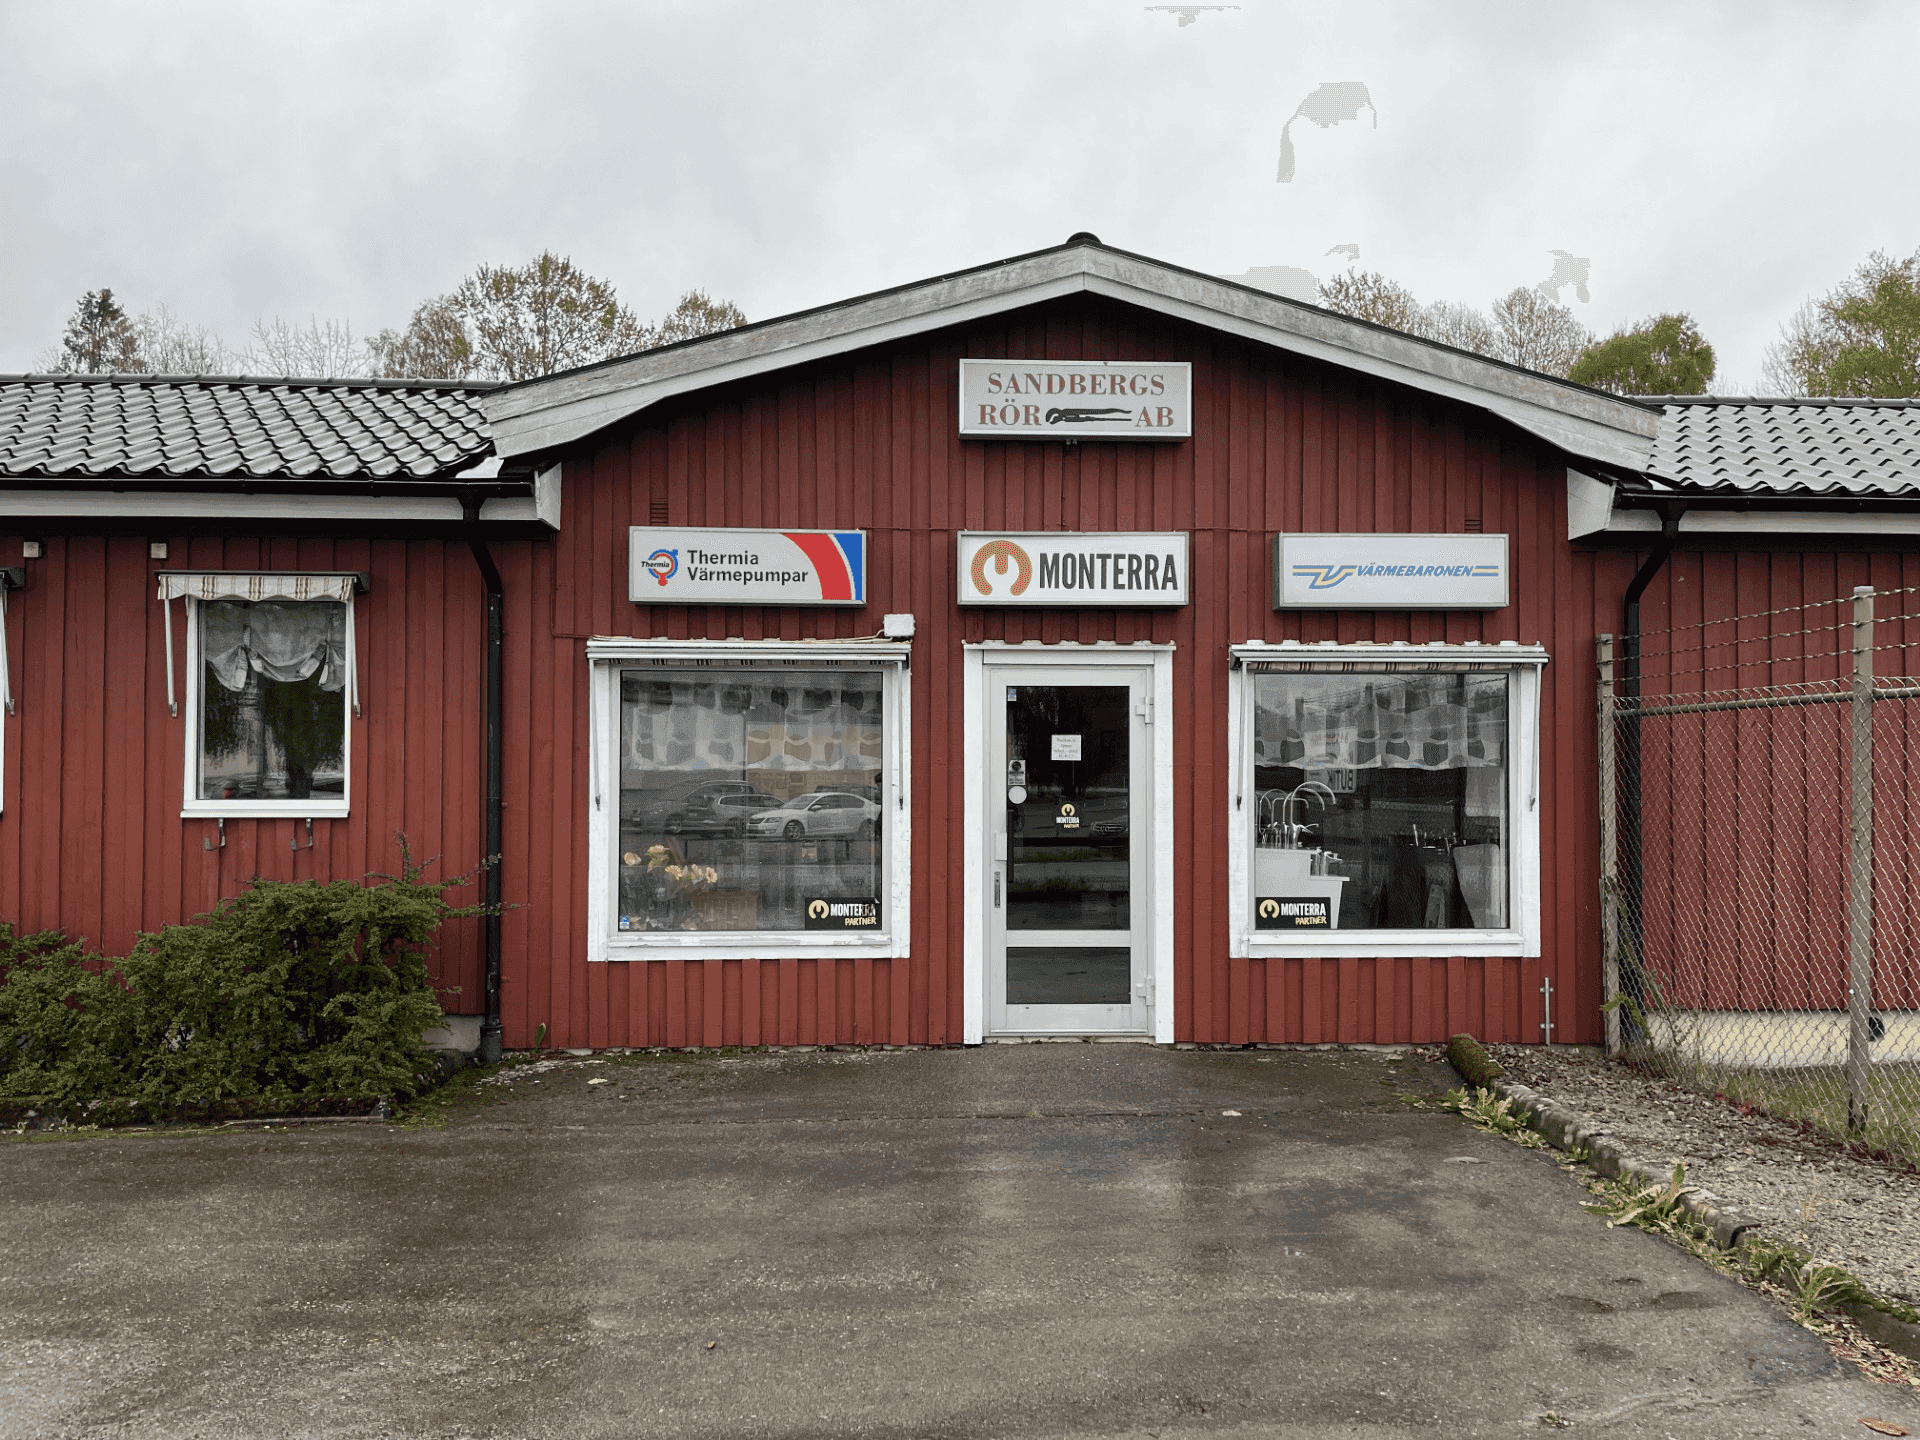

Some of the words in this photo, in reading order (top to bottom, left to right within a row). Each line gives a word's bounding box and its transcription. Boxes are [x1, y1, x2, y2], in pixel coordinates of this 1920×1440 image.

[987, 372, 1165, 396] SANDBERGS
[977, 398, 1042, 426] RÖR
[1135, 406, 1174, 428] AB
[687, 549, 759, 565] Thermia
[641, 561, 670, 569] Thermia
[1039, 552, 1178, 591] MONTERRA
[1357, 562, 1474, 577] VÄRMEBARONEN
[687, 566, 808, 586] Värmepumpar
[830, 903, 876, 917] MONTERRA
[1280, 902, 1327, 916] MONTERRA
[844, 916, 877, 926] PARTNER
[1295, 916, 1327, 925] PARTNER
